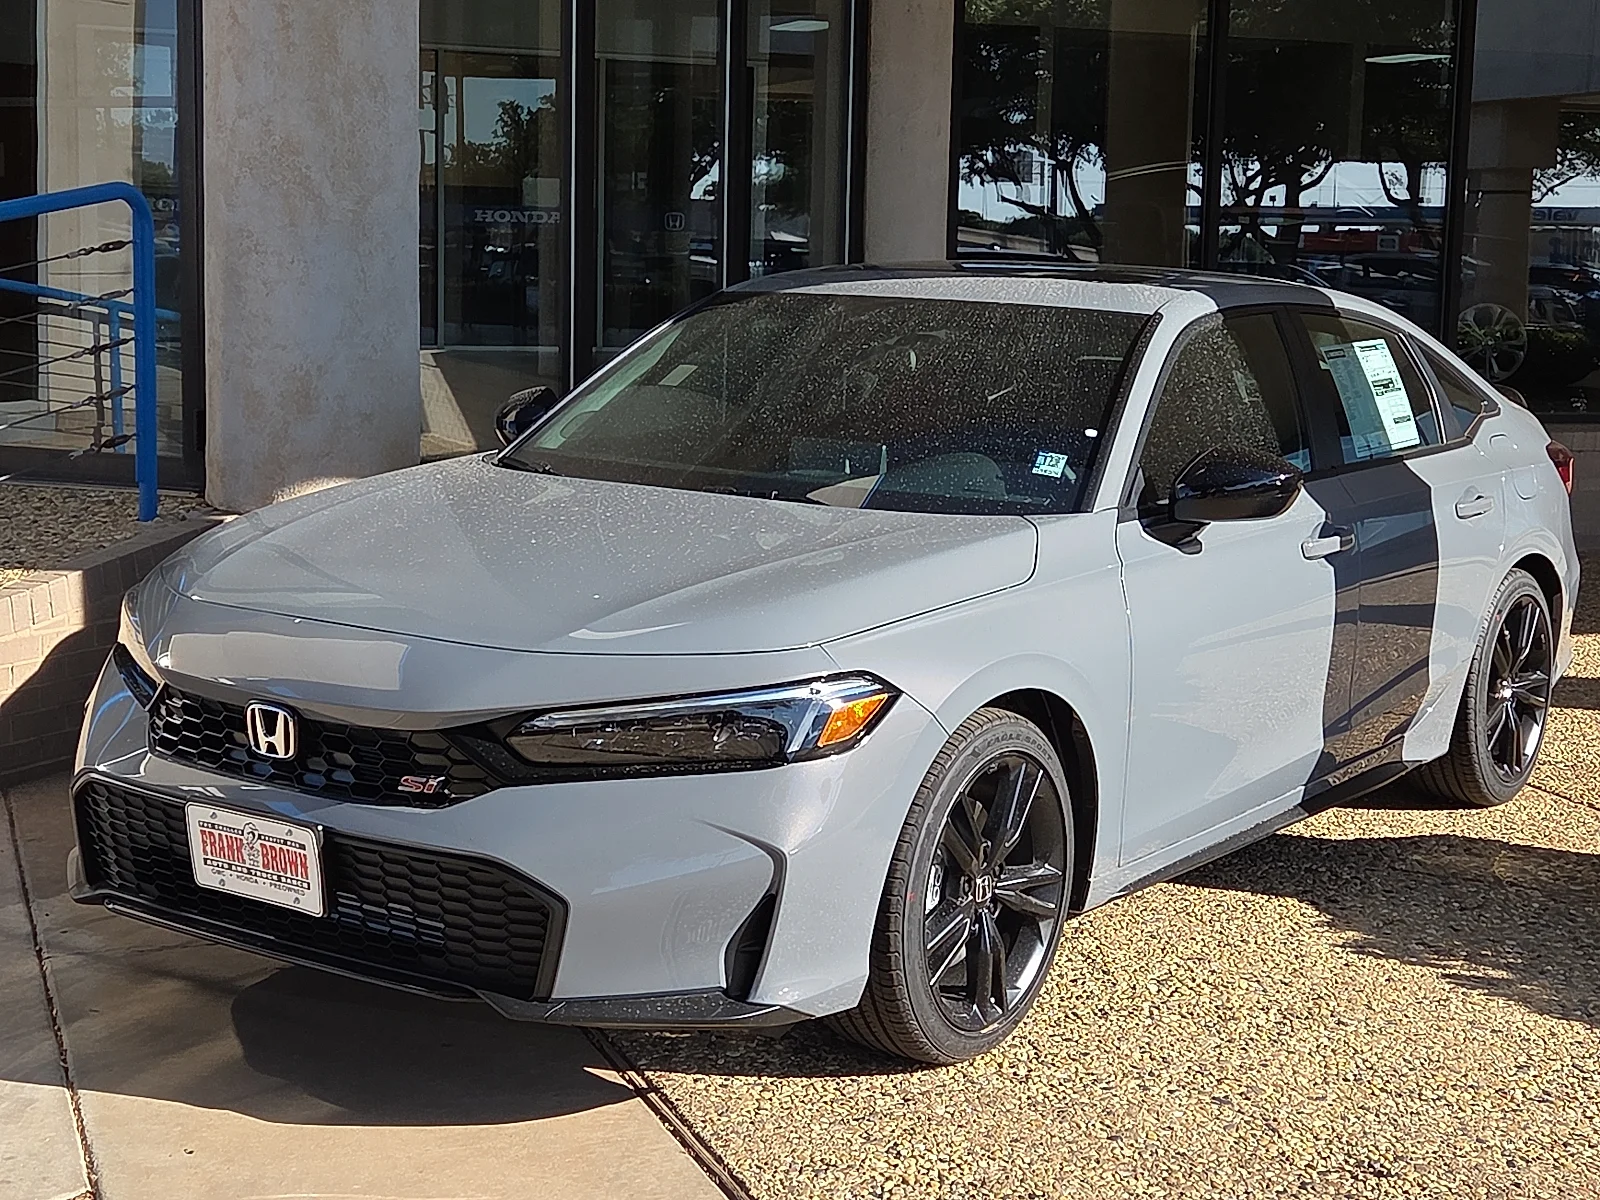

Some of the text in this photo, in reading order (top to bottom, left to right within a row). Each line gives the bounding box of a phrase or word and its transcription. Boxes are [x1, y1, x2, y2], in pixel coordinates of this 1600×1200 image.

[474, 209, 560, 223] HONDA
[1024, 735, 1053, 761] SPORT
[200, 829, 309, 880] FRANK BROWN
[206, 859, 229, 869] AUTO
[250, 868, 278, 881] TRUCK
[280, 876, 309, 889] RANCH
